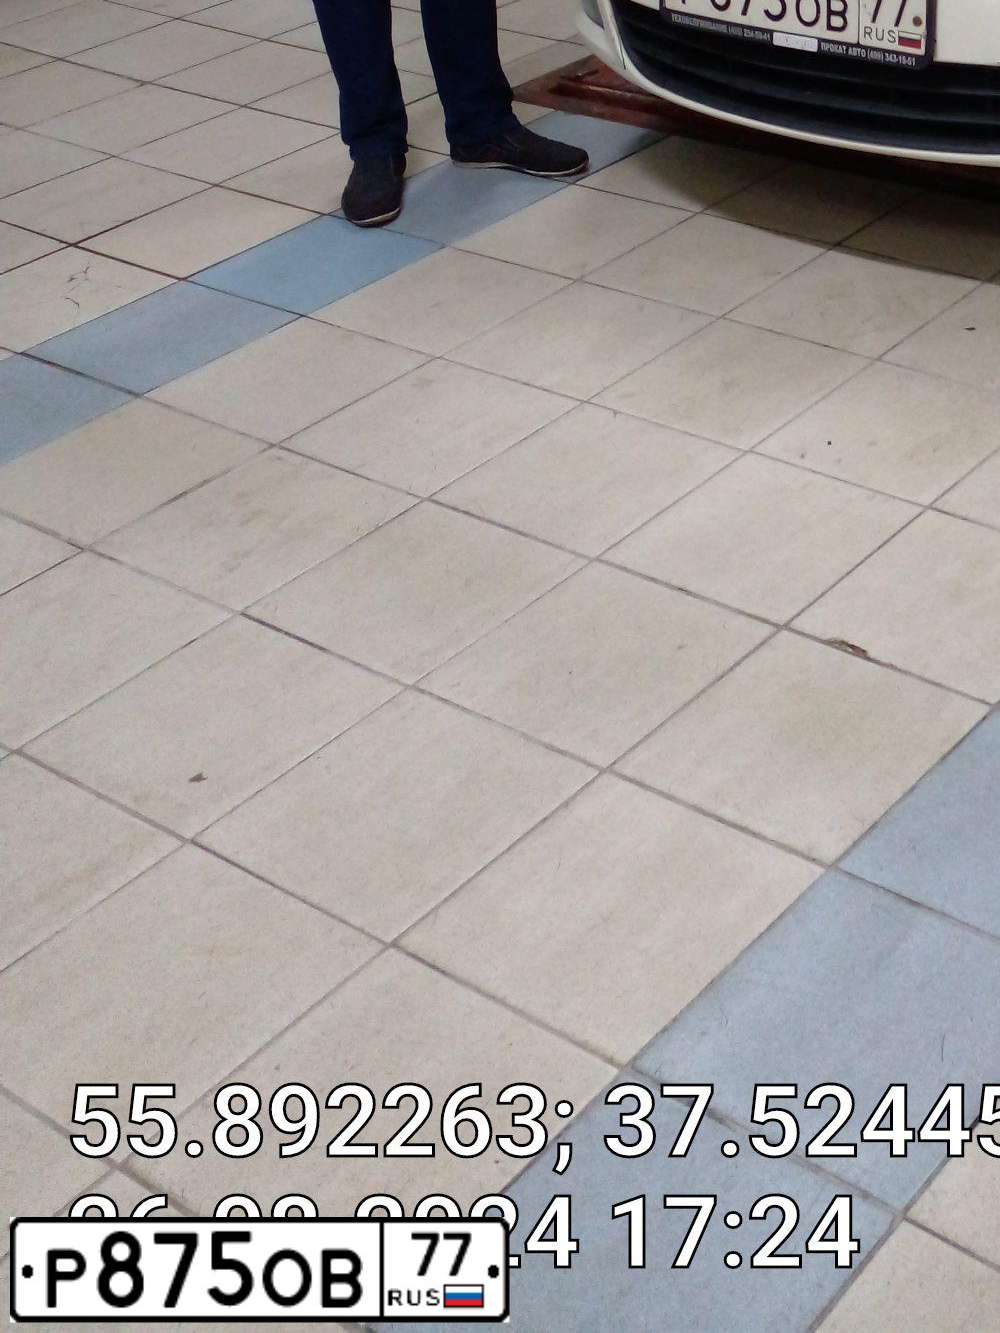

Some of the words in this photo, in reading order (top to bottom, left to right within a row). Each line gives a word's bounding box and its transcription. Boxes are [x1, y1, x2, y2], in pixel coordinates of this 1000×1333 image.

[863, 26, 897, 44] RUS
[820, 42, 846, 54] ПРОКАТ
[848, 47, 866, 58] АВТО
